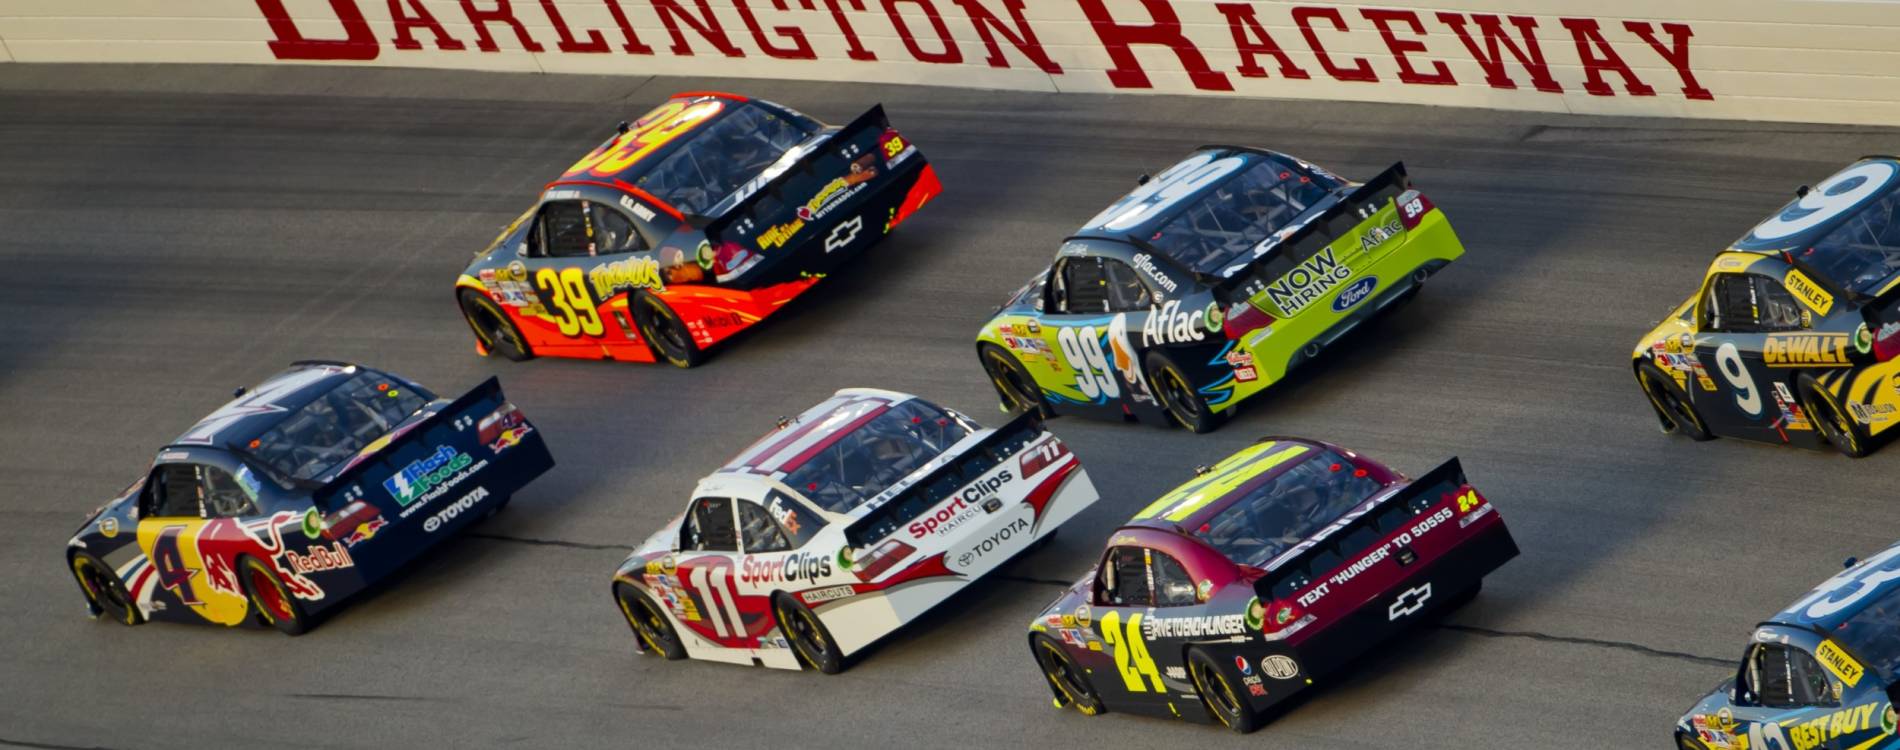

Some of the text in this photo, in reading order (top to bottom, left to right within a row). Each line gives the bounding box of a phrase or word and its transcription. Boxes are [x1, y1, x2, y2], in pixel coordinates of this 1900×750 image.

[266, 0, 1714, 100] DARLINGTON RACEWAY
[884, 136, 904, 158] 39
[1404, 198, 1424, 218] 99
[1753, 163, 1894, 240] 9
[1133, 253, 1177, 293] aflac.com
[1266, 245, 1339, 306] NOW
[1281, 266, 1350, 316] HIRING
[1787, 274, 1829, 310] STANLEY
[536, 266, 604, 337] 39
[1340, 282, 1370, 308] Ford
[1142, 299, 1205, 347] Aflac
[1057, 325, 1120, 399] 99
[1715, 342, 1763, 416] 9
[500, 412, 514, 429] 4
[407, 444, 458, 482] Flash
[1036, 439, 1061, 462] 11
[417, 452, 472, 491] Foods
[437, 486, 490, 523] TOYOTA
[769, 495, 801, 535] FedEx
[1456, 489, 1479, 513] 24
[972, 517, 1028, 558] TOYOTA
[1297, 582, 1330, 608] TEXT
[1329, 542, 1391, 585] "HUNGER"
[1391, 532, 1412, 549] TO
[1410, 506, 1454, 537] 50555
[153, 524, 204, 606] 4
[689, 565, 749, 638] 11
[804, 585, 854, 602] HAIRCUTS
[1100, 610, 1168, 693] 24
[1817, 644, 1860, 679] STANLEY
[1789, 713, 1832, 750] BEST
[1829, 701, 1879, 739] BUY
